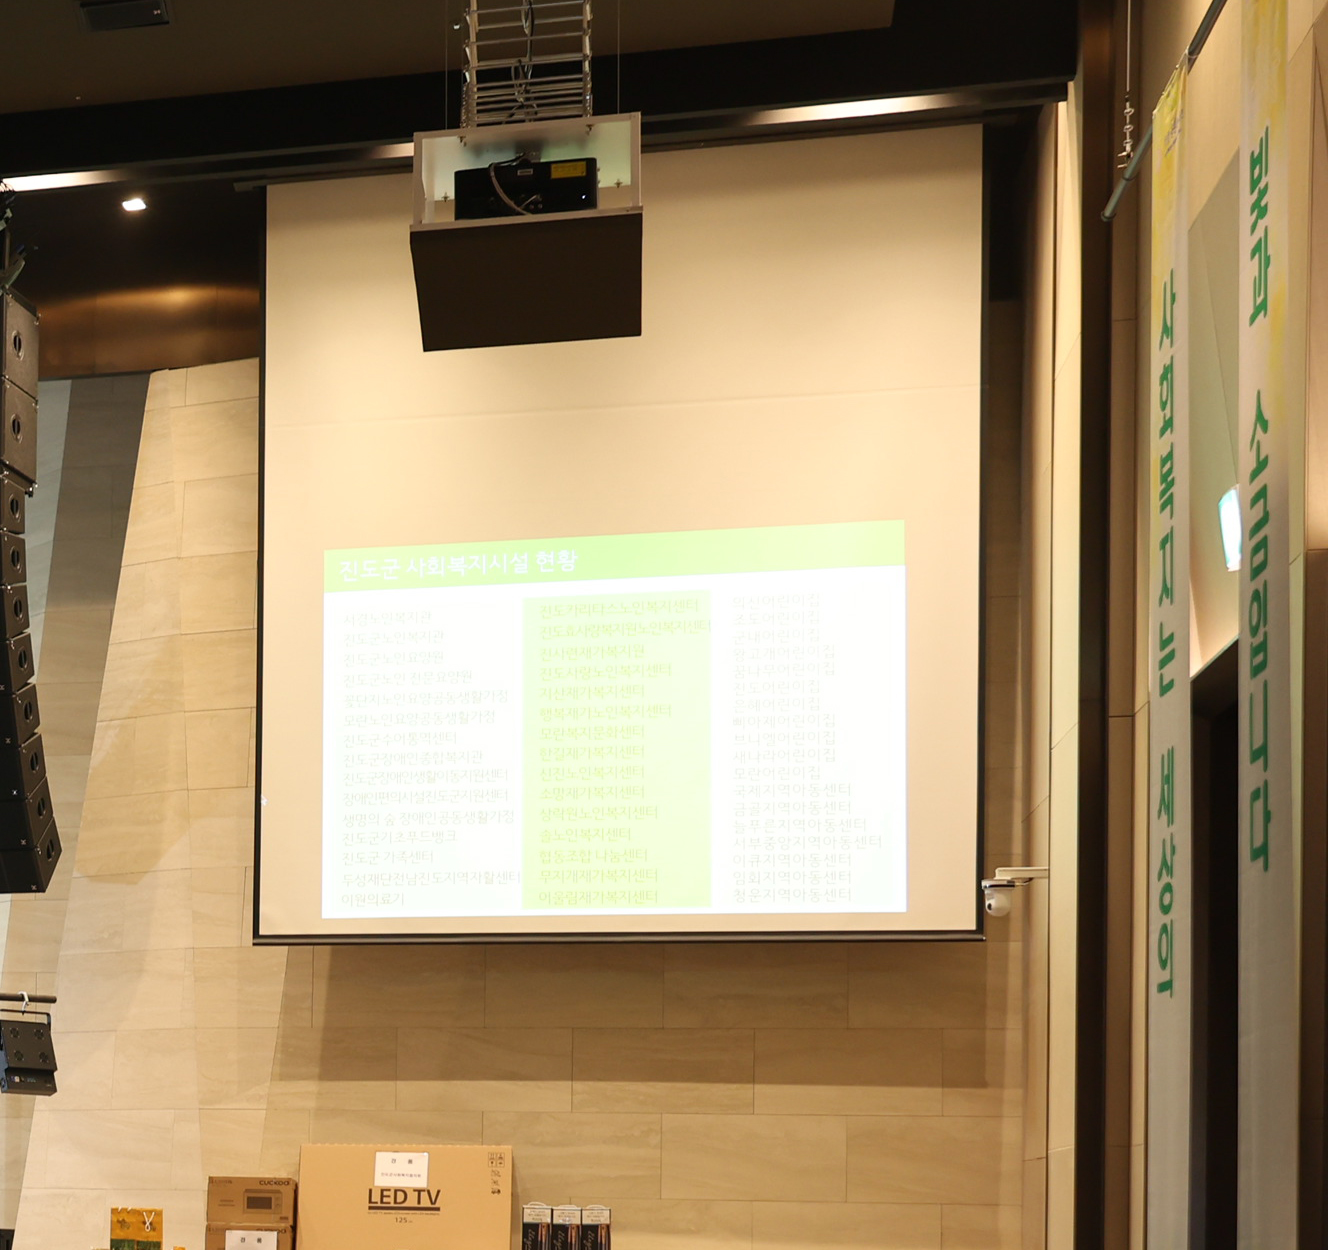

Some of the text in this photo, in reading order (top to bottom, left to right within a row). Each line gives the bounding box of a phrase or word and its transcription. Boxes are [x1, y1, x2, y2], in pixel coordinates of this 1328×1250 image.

[1158, 267, 1176, 698] 사회복지는
[1248, 124, 1272, 873] 빛과 소금입니다
[338, 548, 579, 583] 진도군 사회복지시설 현황
[1157, 744, 1175, 998] 세상의
[368, 1188, 441, 1206] LED TV
[395, 1216, 408, 1224] 125
